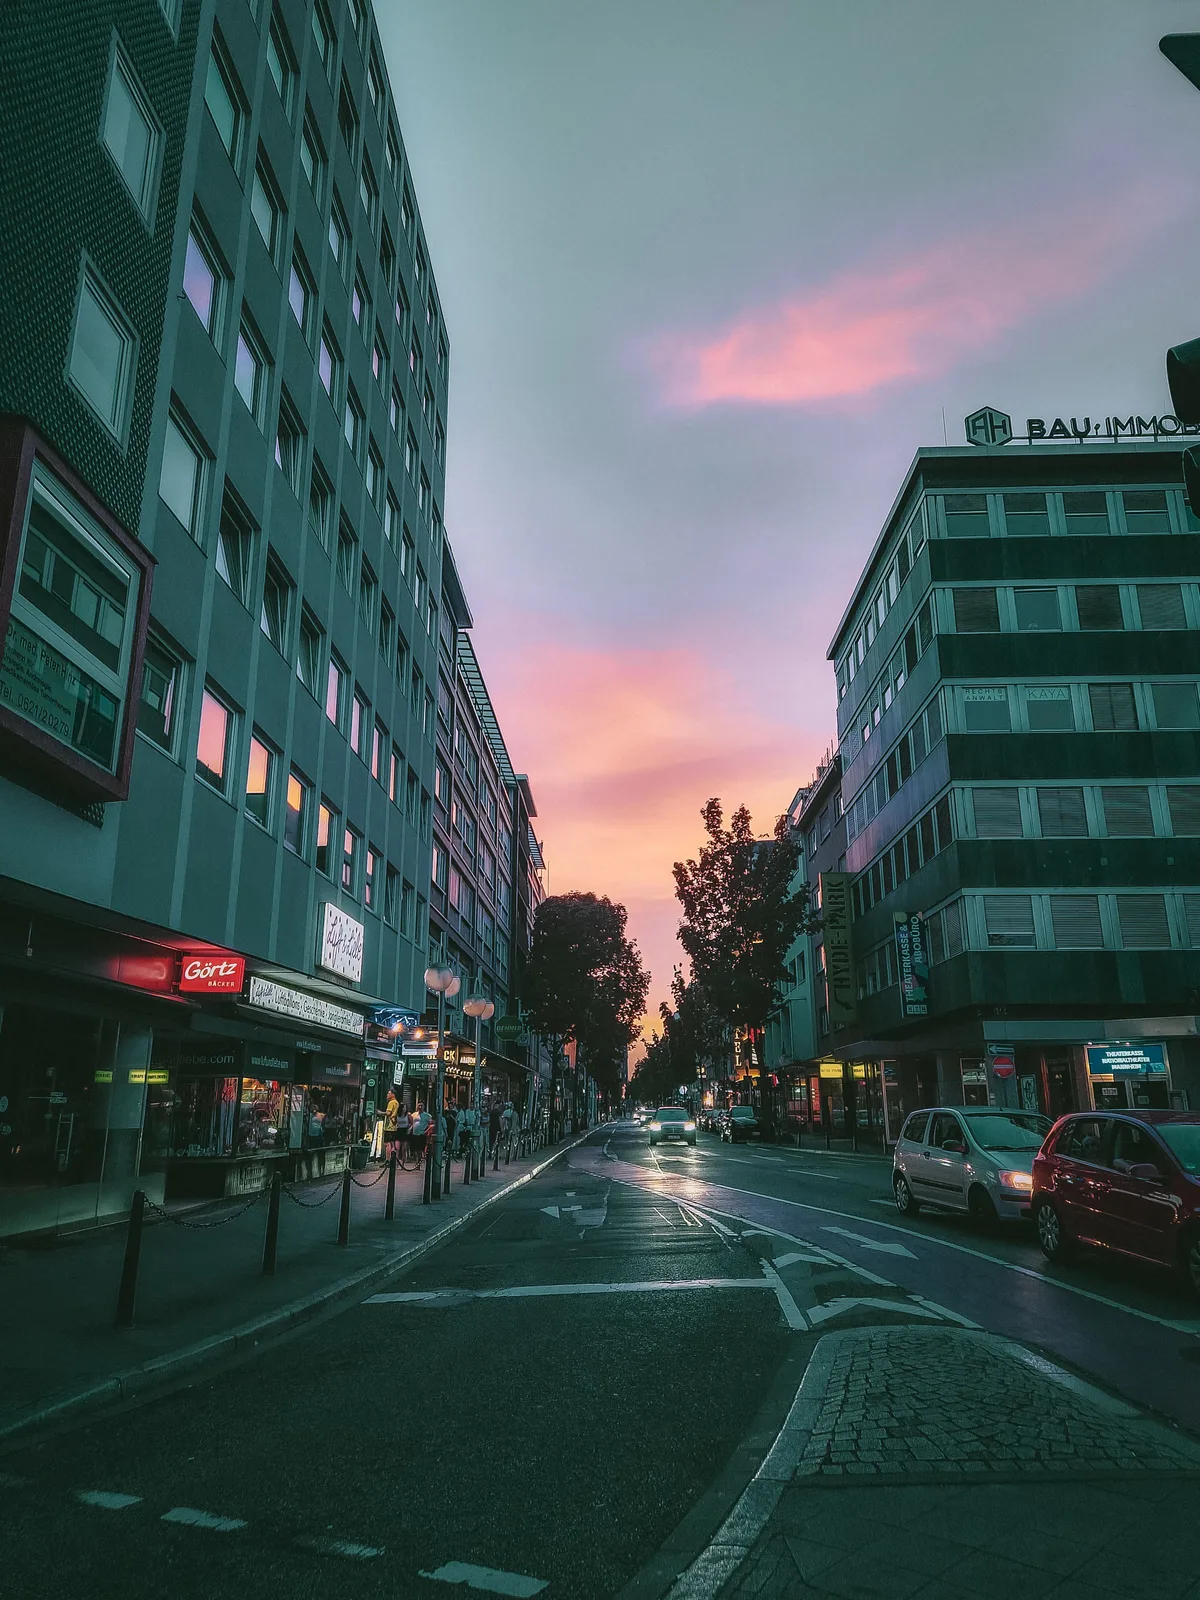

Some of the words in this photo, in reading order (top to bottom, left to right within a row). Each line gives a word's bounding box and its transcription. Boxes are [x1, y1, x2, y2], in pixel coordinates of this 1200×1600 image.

[1027, 417, 1091, 437] BAU
[1028, 688, 1067, 699] KAYA
[900, 924, 908, 932] &
[910, 916, 923, 964] ABOBÜRO
[185, 961, 237, 980] Görtz
[900, 933, 915, 1003] THEATERKASSE
